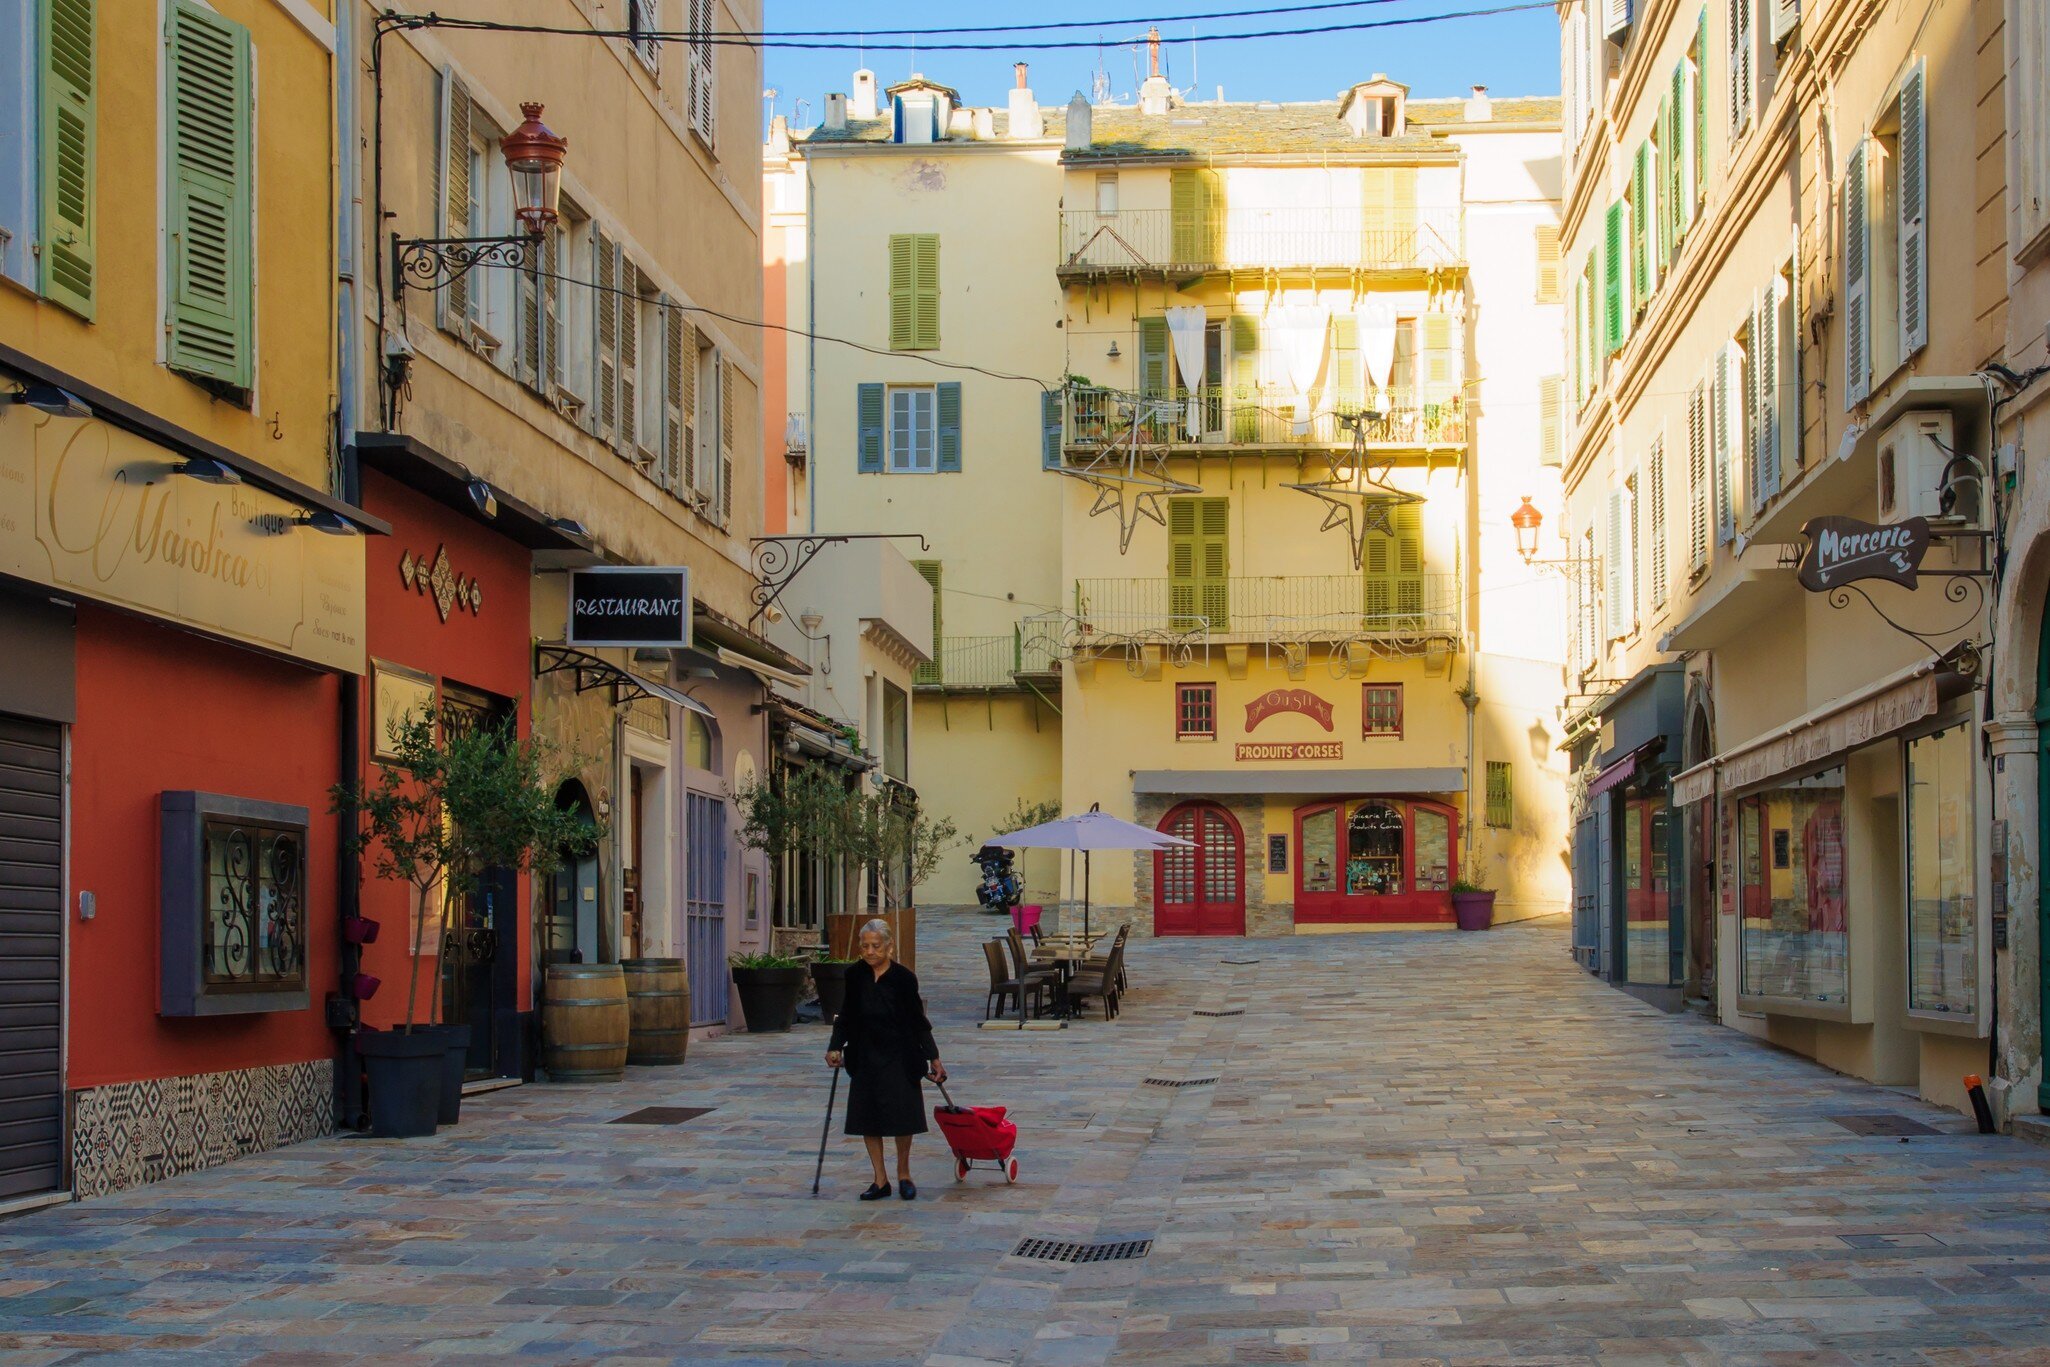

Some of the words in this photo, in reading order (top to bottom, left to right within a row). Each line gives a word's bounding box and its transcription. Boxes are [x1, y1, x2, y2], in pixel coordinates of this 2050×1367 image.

[231, 486, 284, 537] Boutique
[1818, 527, 1915, 568] Mercerie
[575, 598, 681, 616] RESTAURANT
[1239, 745, 1293, 759] PRODUITS
[1297, 744, 1341, 758] CORSES
[1384, 809, 1402, 819] Fine
[1349, 822, 1377, 830] Produits
[1380, 822, 1402, 830] Corses
